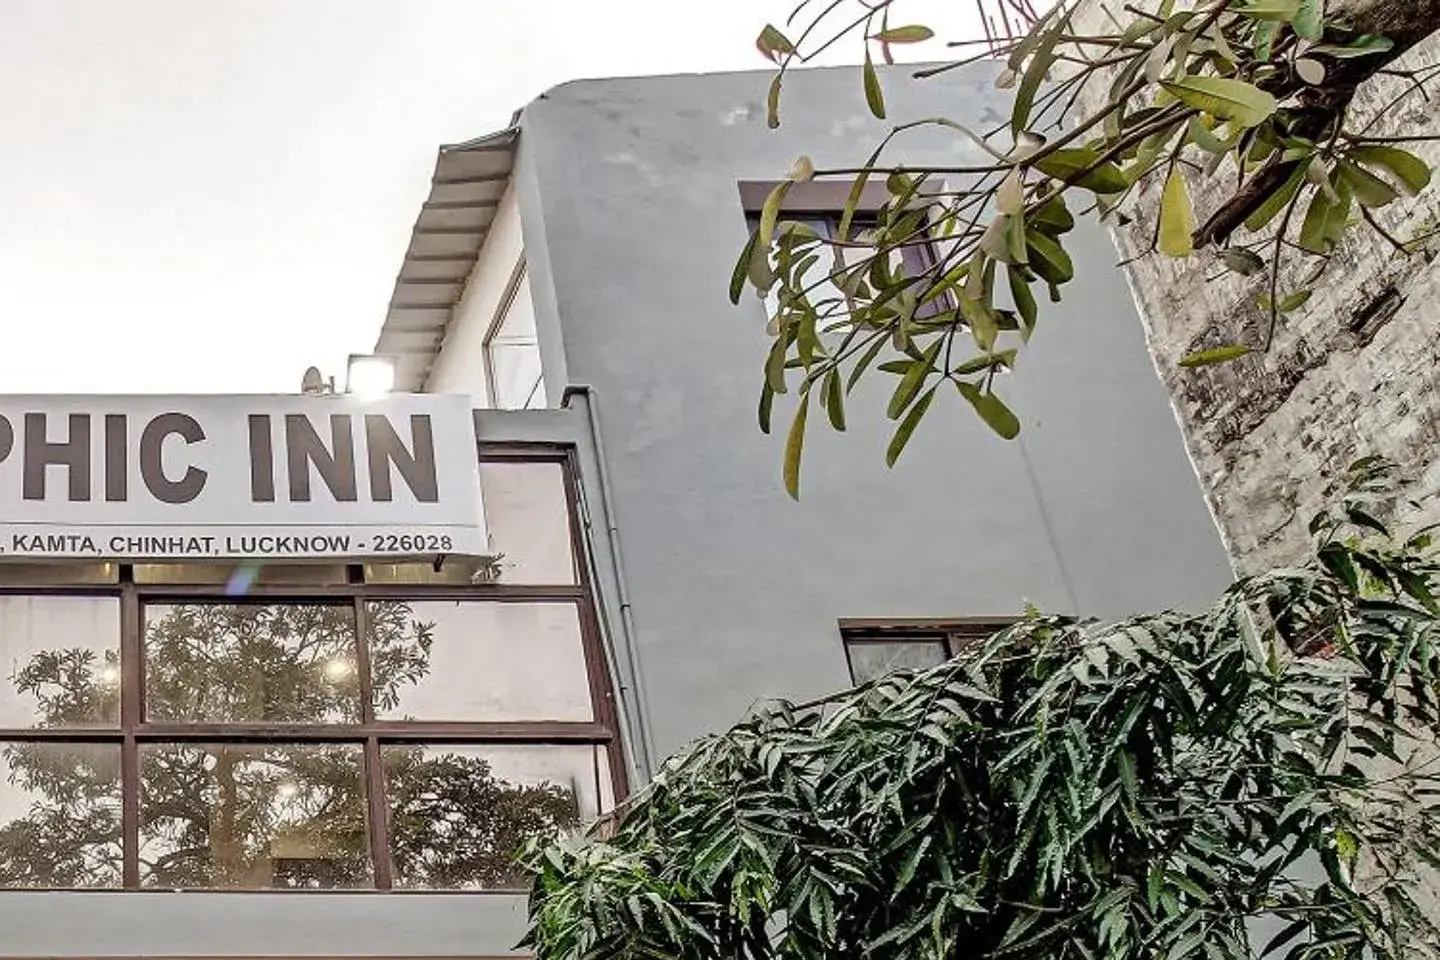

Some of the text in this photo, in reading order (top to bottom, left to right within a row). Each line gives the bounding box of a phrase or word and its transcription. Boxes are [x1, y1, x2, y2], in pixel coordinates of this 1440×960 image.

[248, 414, 439, 502] INN
[13, 535, 102, 556] KAMTA,
[109, 536, 219, 556] CHINHAT,
[227, 535, 350, 554] LUCKNOW
[372, 534, 453, 553] 226028
